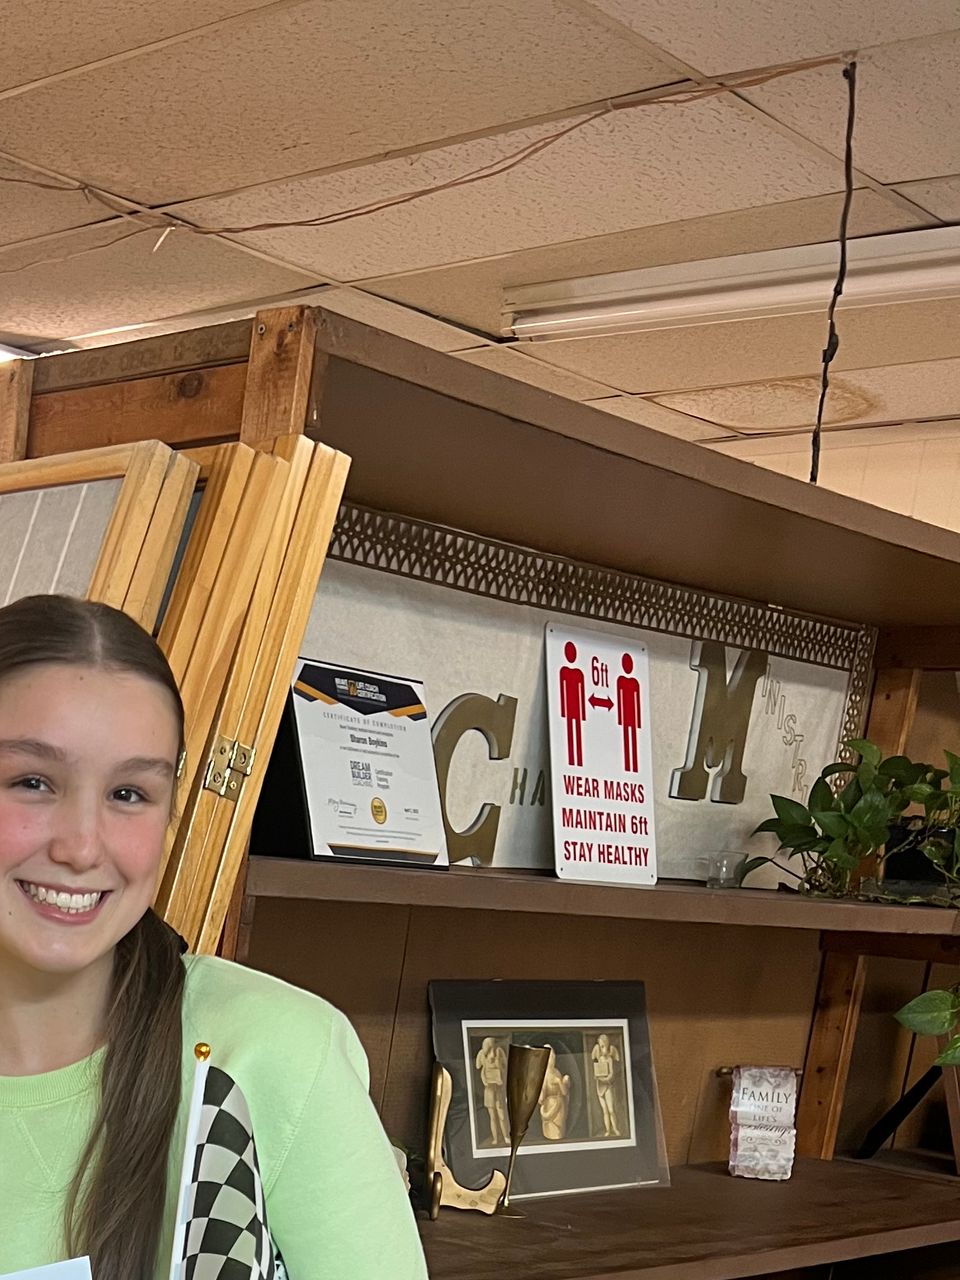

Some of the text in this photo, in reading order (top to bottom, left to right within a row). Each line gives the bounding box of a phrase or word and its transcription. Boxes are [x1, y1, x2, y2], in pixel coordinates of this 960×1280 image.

[591, 655, 609, 688] 6ft
[349, 760, 371, 772] DREAM
[351, 770, 372, 780] BUILDER
[563, 774, 645, 804] WEAR MASKS
[562, 807, 649, 836] MAINTAIN 6ft
[563, 840, 649, 867] STAY HEALTHY
[741, 1087, 791, 1104] FAMILY
